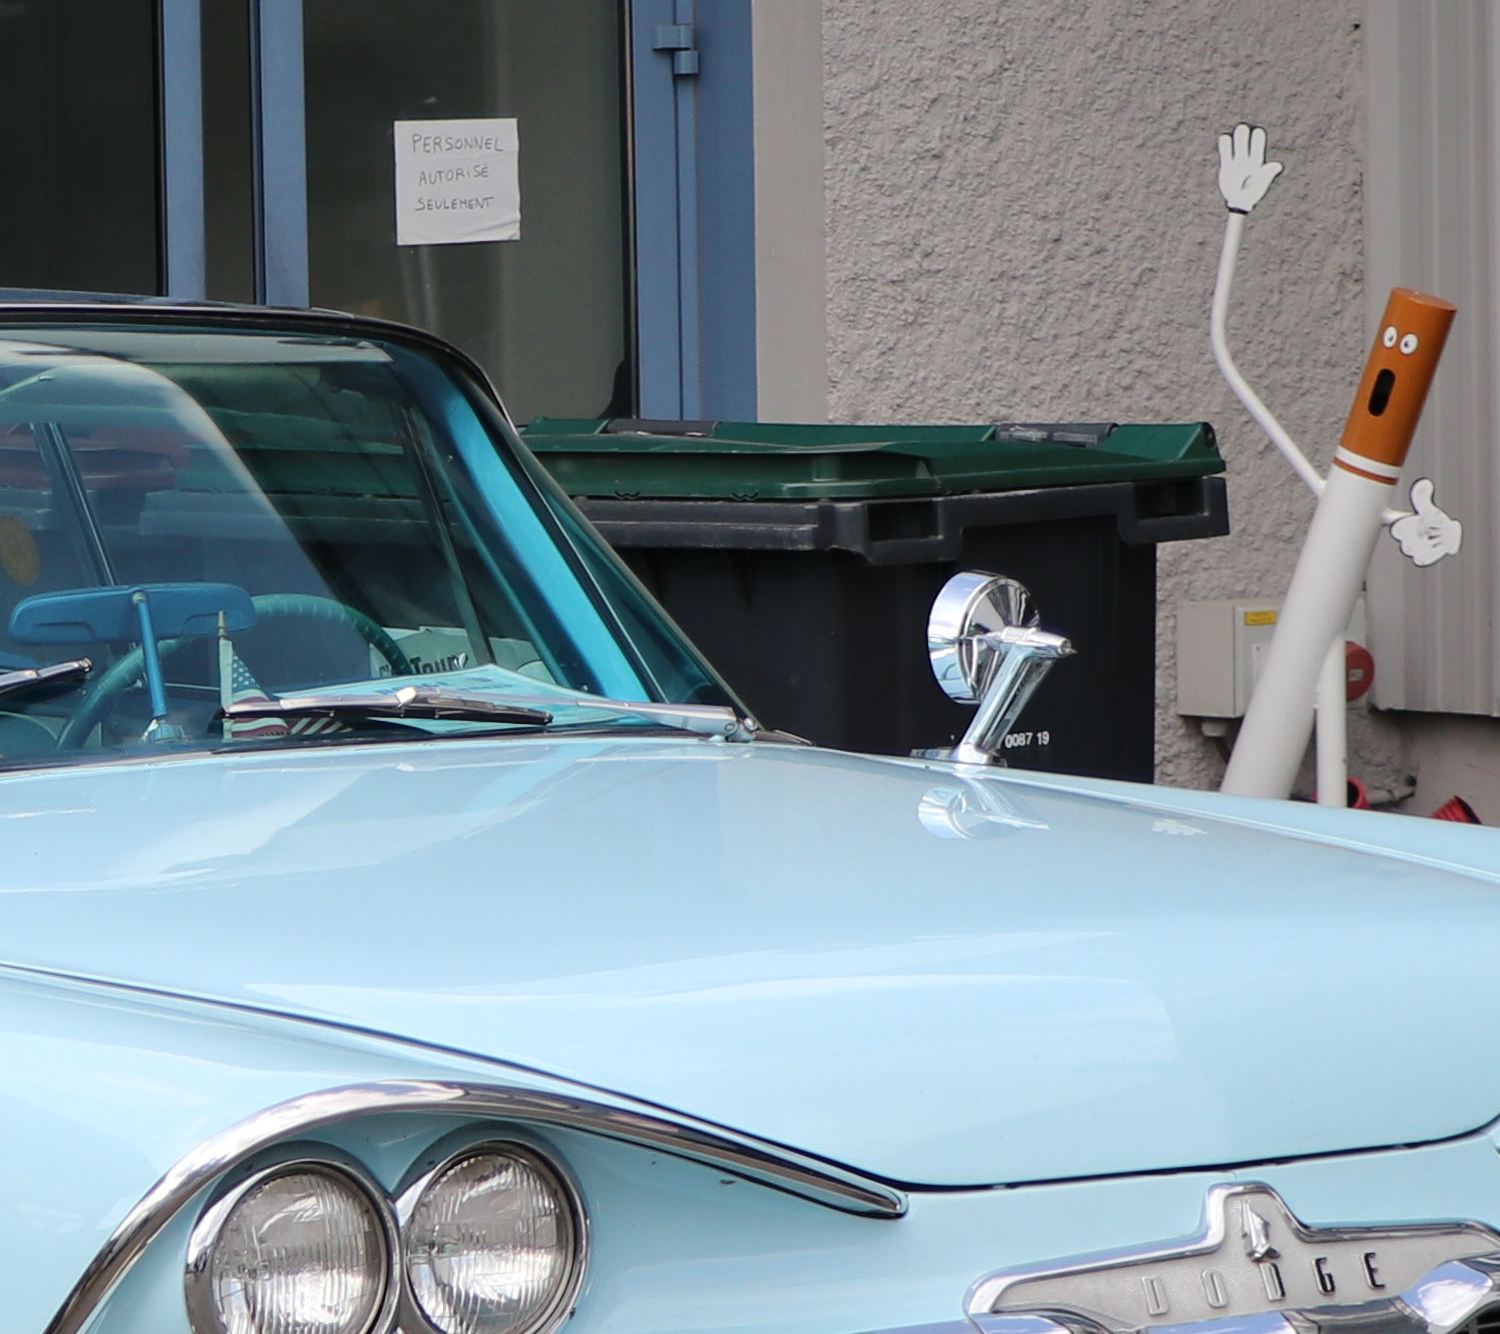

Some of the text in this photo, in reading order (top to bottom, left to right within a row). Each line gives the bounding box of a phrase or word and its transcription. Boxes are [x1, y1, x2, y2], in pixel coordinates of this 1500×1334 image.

[411, 133, 504, 154] PERSONNEL
[414, 196, 495, 212] SEULEMENT
[1036, 730, 1051, 746] 19
[1141, 1251, 1387, 1317] DODGE
